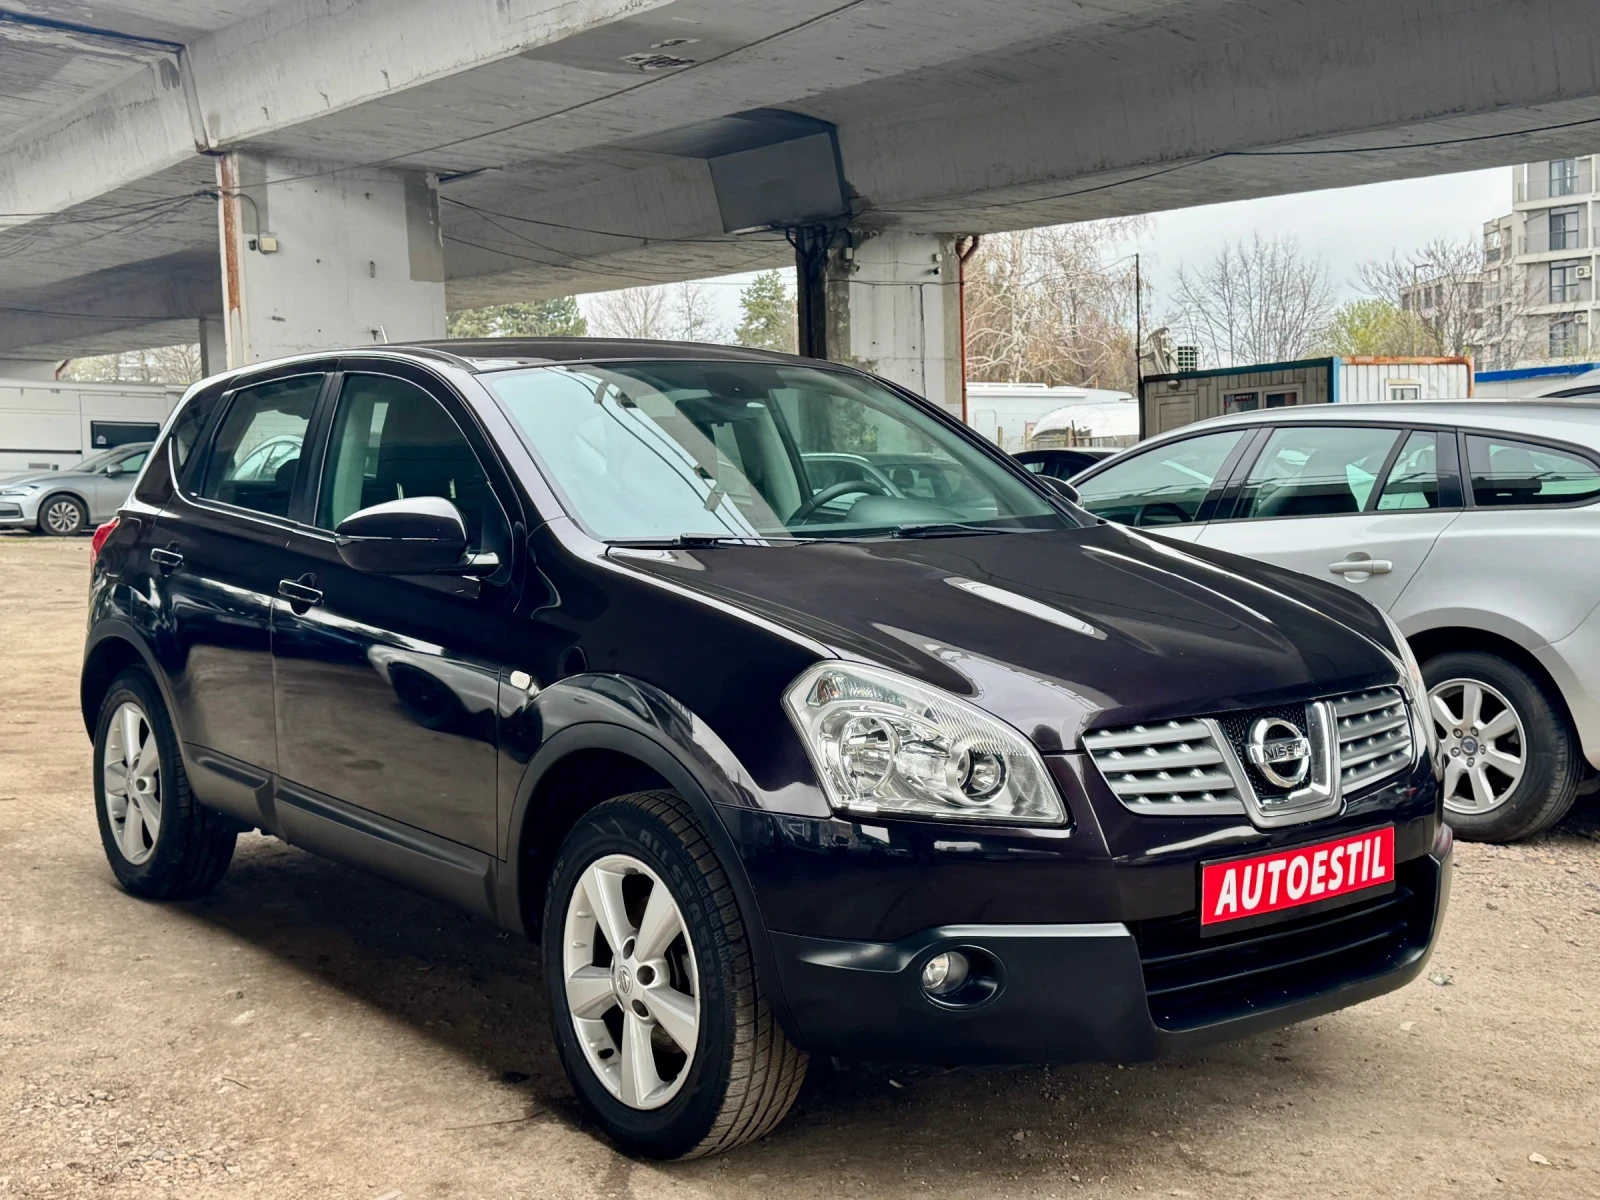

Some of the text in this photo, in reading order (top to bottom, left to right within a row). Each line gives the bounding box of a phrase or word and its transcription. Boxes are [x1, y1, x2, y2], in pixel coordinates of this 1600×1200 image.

[638, 828, 718, 999] ALL SEASON
[1214, 836, 1385, 916] AUTOESTIL
